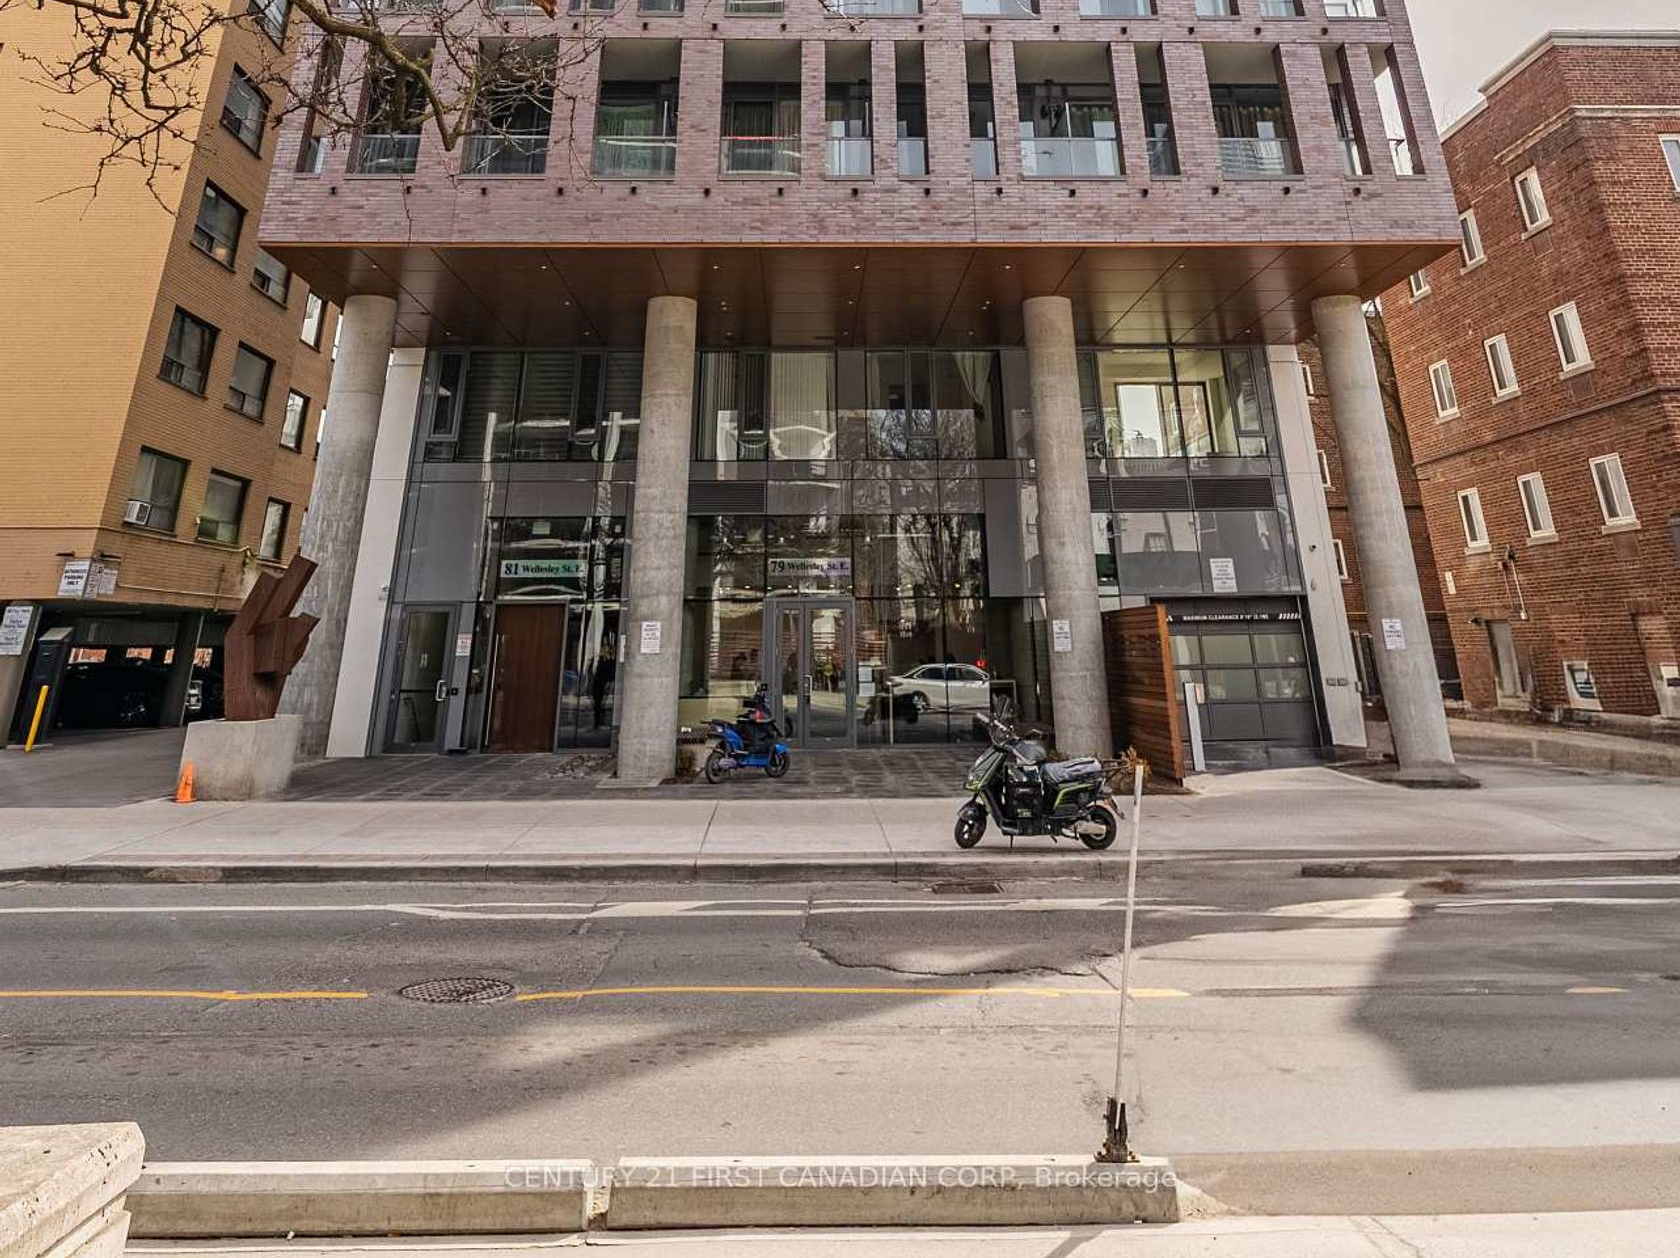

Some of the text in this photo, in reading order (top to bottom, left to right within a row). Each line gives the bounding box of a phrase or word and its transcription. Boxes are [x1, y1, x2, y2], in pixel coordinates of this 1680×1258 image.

[504, 562, 519, 575] 81
[521, 563, 560, 574] Wellesley
[562, 563, 573, 573] St.
[771, 560, 849, 573] 79 Wellesley St. E.
